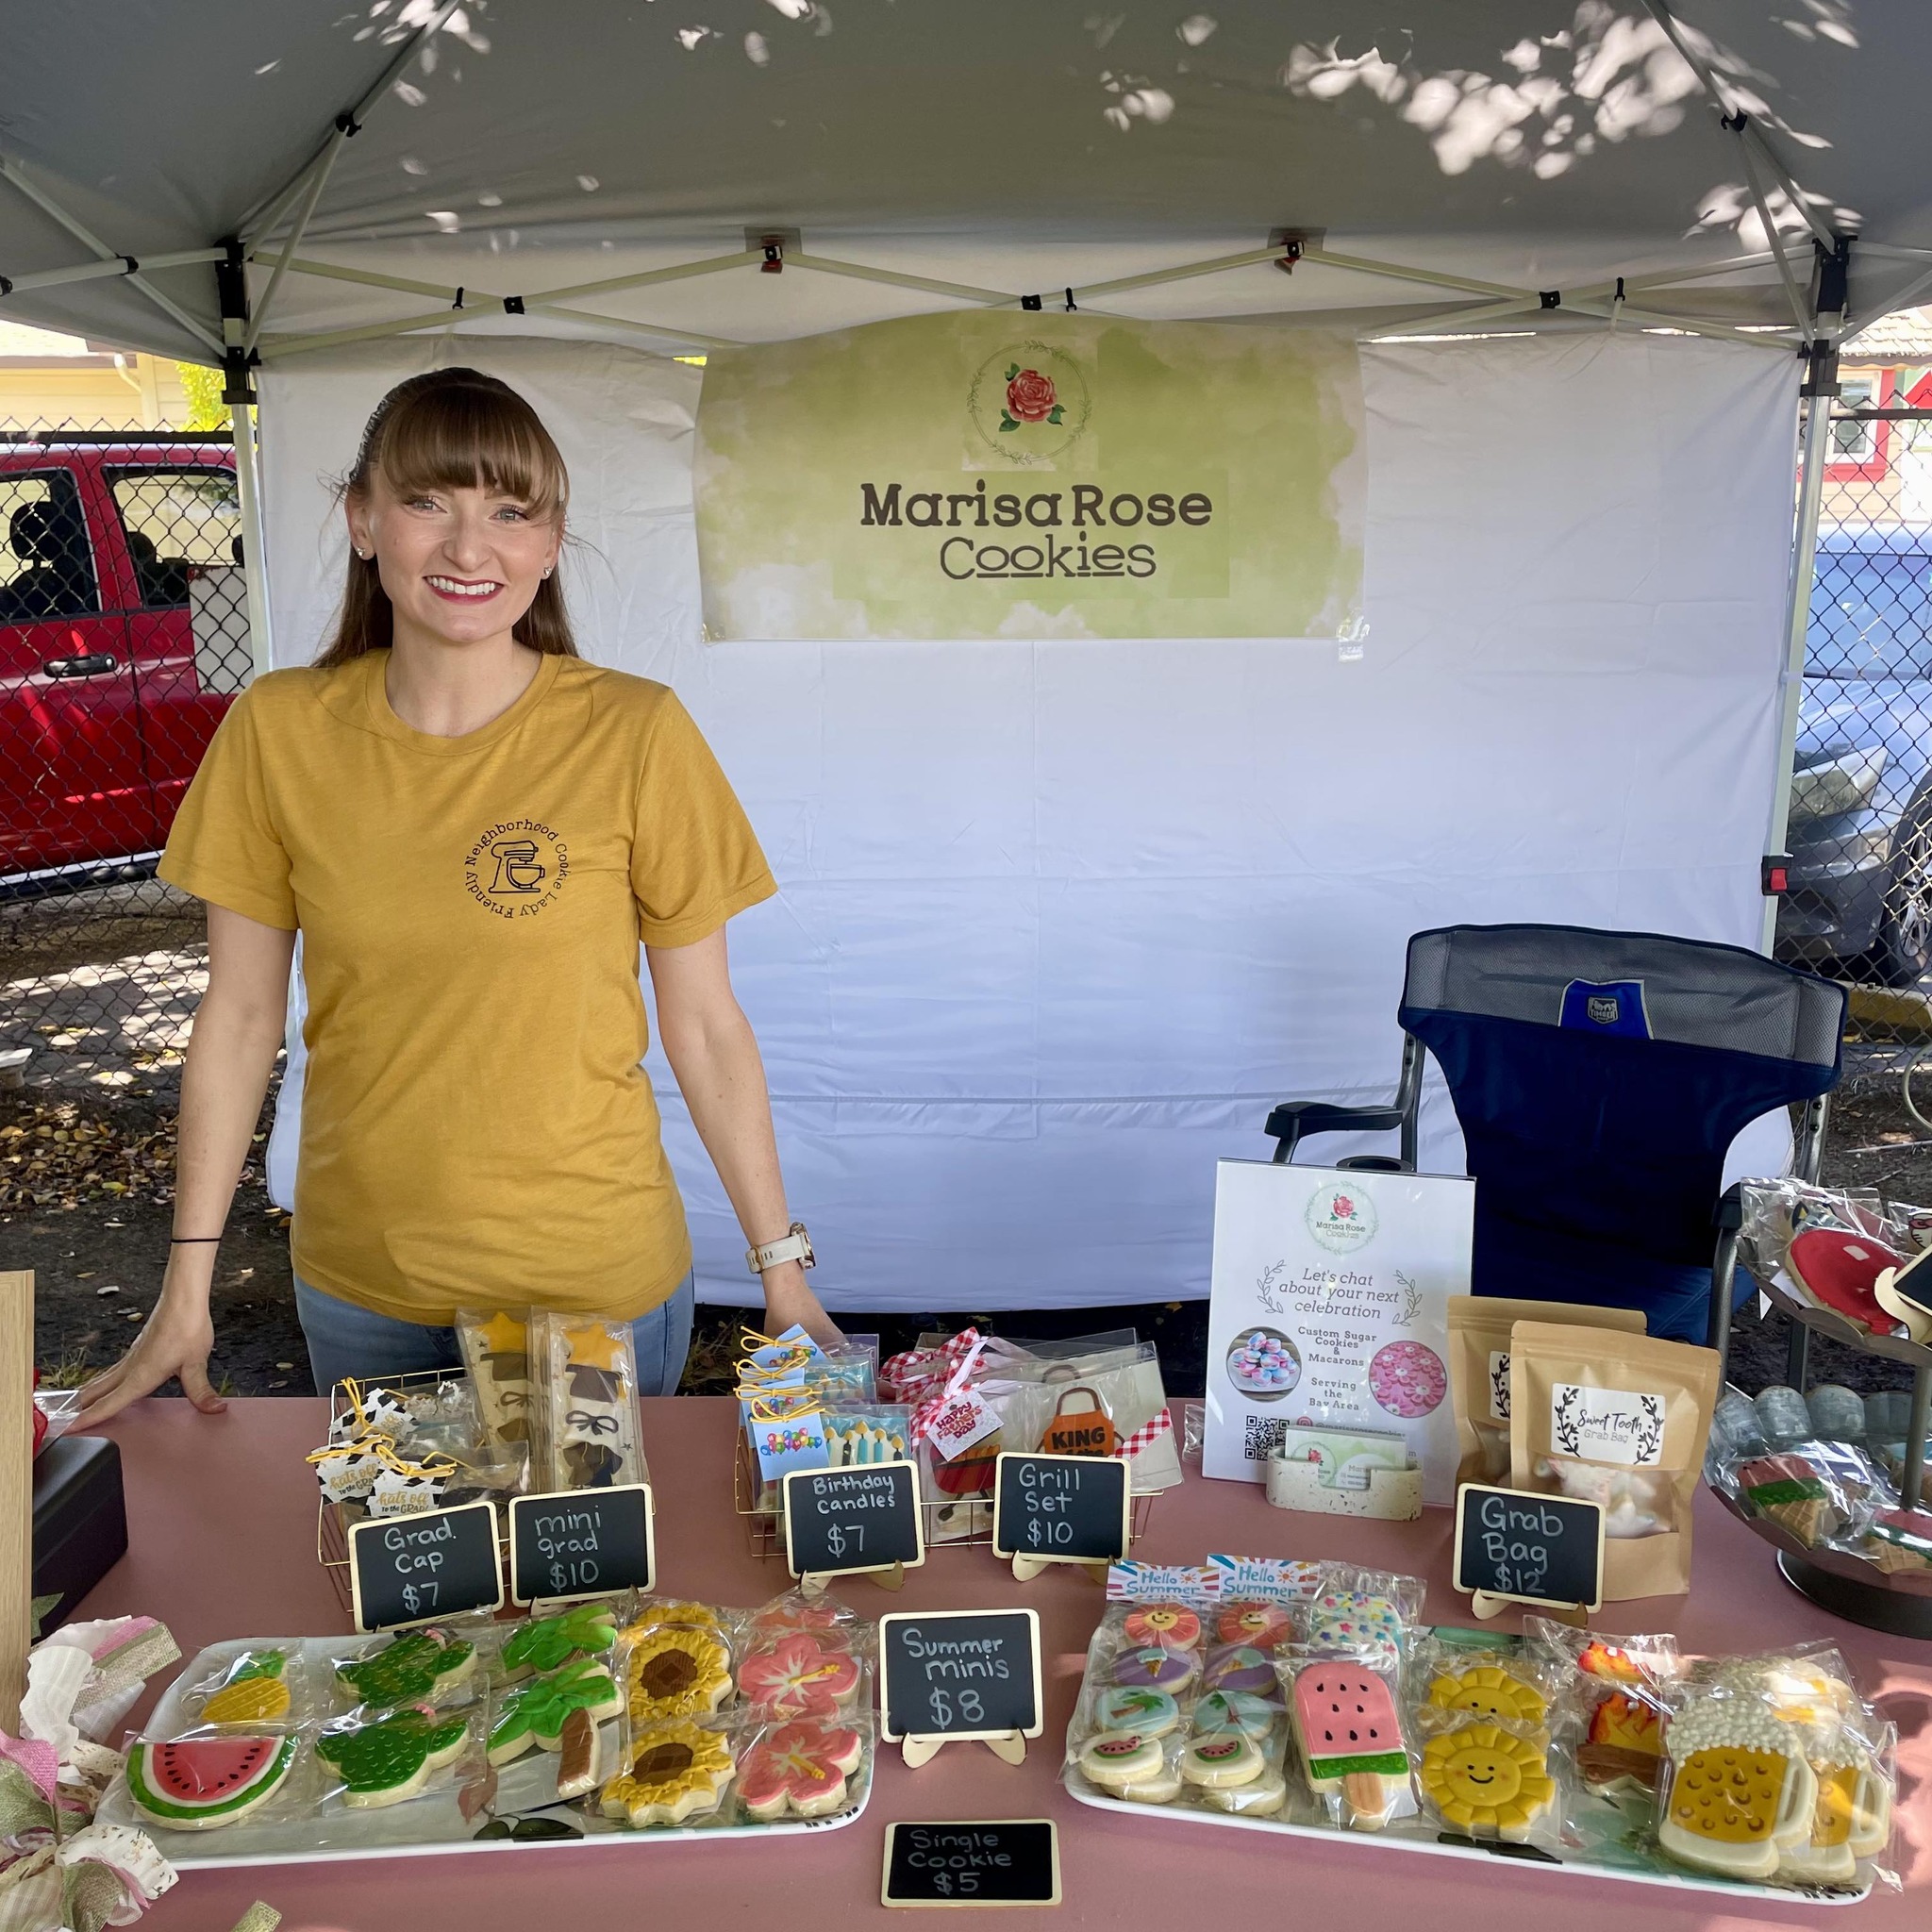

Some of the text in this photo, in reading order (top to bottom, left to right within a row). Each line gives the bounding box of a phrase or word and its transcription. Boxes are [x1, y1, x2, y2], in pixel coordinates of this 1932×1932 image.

[860, 478, 1213, 526] Marisa Rose
[940, 530, 1158, 580] Cookies
[464, 819, 572, 919] Friendly Neighborhood Cookie Lady
[1315, 1221, 1367, 1233] Marisa Rose
[1302, 1268, 1374, 1286] Let's chat
[1279, 1281, 1399, 1303] about your next
[1294, 1300, 1381, 1319] celebration
[1298, 1326, 1377, 1342] Custom Sugar
[1315, 1337, 1359, 1348] Cookies
[1308, 1353, 1364, 1366] Macarons
[1333, 1346, 1341, 1356] &
[1311, 1377, 1357, 1391] Serving
[1324, 1389, 1342, 1398] the
[1332, 1400, 1359, 1410] Area
[1577, 1409, 1642, 1434] Sweet Tooth
[1051, 1426, 1106, 1450] KING
[1584, 1429, 1629, 1443] Grab Bag
[812, 1474, 895, 1495] Birthday
[1019, 1462, 1080, 1491] Grill
[376, 1491, 429, 1506] hats off
[1024, 1491, 1073, 1513] Set
[534, 1505, 601, 1537] mini
[1480, 1496, 1564, 1537] Grab
[384, 1516, 457, 1551] Grad.
[827, 1523, 865, 1558] $7
[1027, 1517, 1074, 1547] $10
[537, 1529, 598, 1559] grad
[1481, 1531, 1548, 1575] Bag
[394, 1551, 444, 1574] Cap
[1239, 1565, 1274, 1583] Hello
[549, 1559, 599, 1593] $10
[1125, 1580, 1201, 1595] Summer
[1141, 1571, 1177, 1585] Hello
[1223, 1576, 1298, 1598] Summer
[1493, 1562, 1546, 1594] $12
[402, 1581, 439, 1615] $7
[901, 1627, 1004, 1658] Summer
[928, 1686, 985, 1730] $8
[909, 1829, 1000, 1853] Single
[908, 1851, 1012, 1868] Cookie
[933, 1871, 981, 1896] $5
